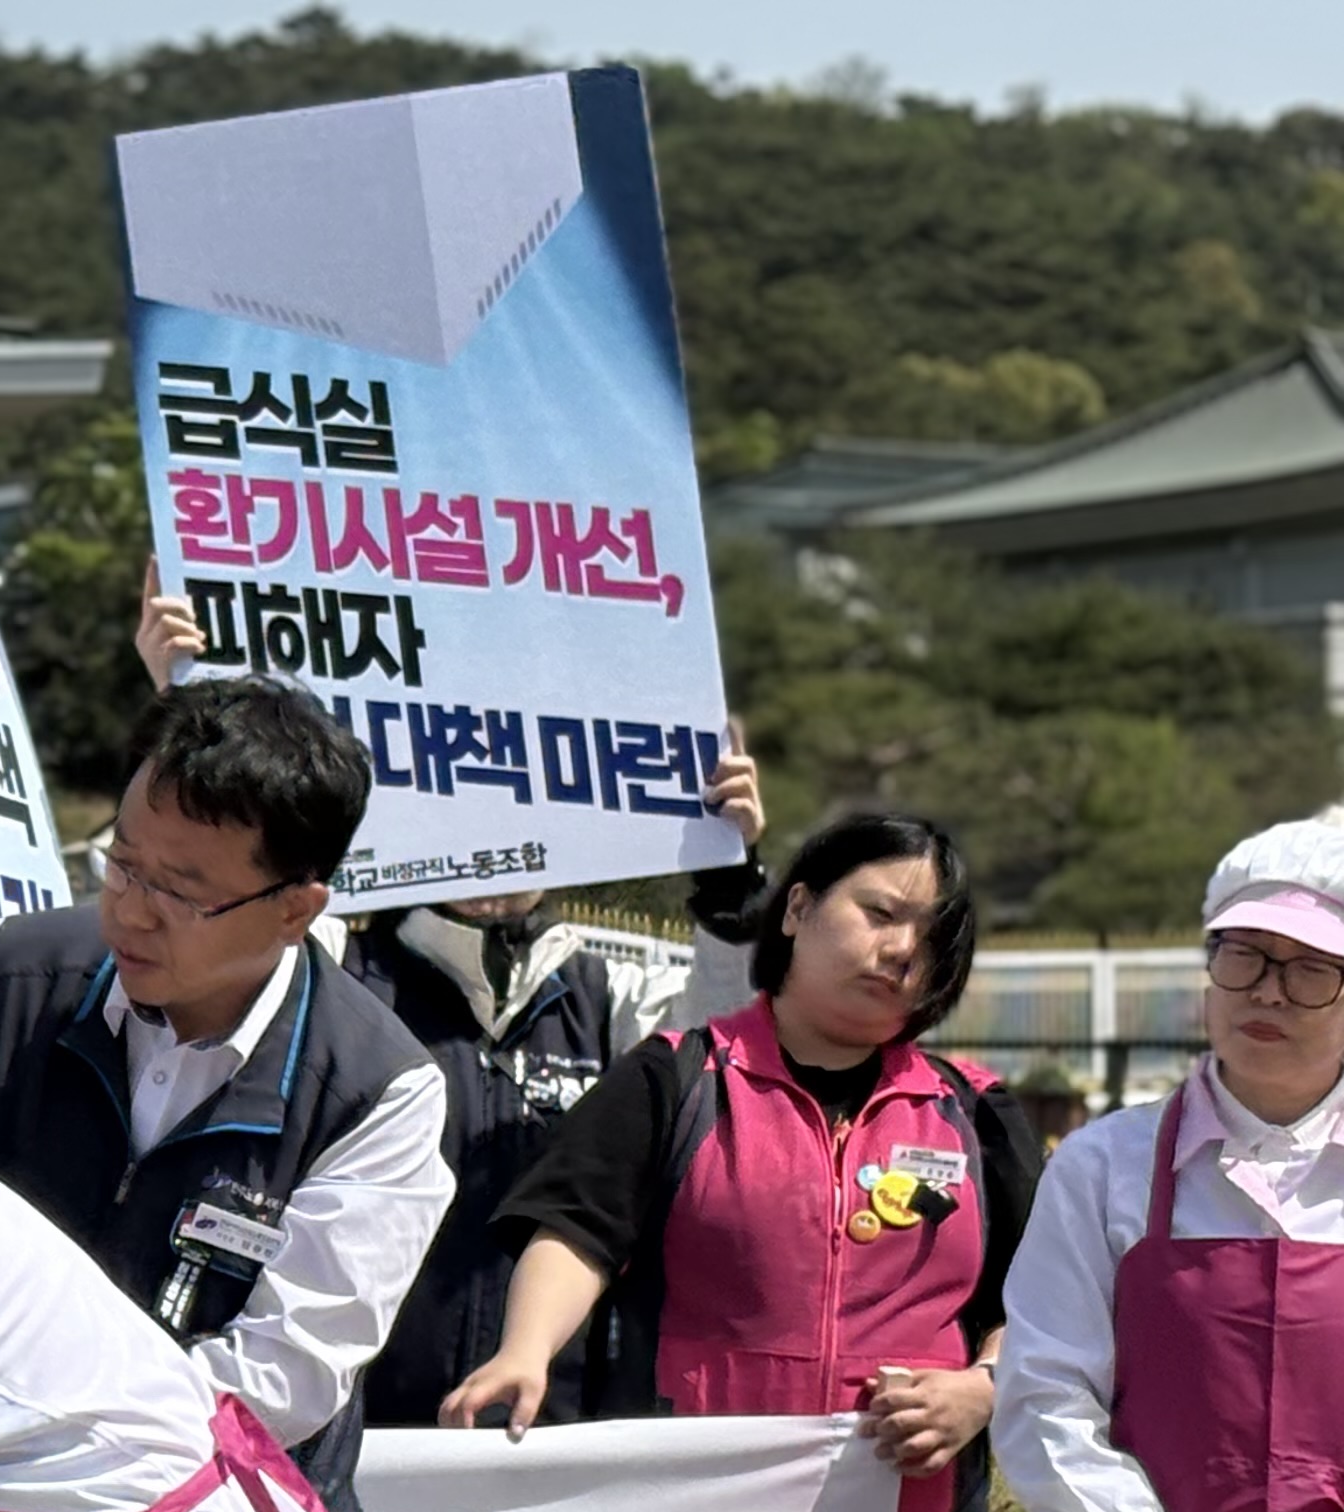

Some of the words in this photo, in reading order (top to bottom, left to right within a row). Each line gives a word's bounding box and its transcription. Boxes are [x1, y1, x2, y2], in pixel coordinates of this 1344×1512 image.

[158, 361, 398, 474] 급식실
[183, 577, 426, 687] 피해자
[366, 699, 532, 805] 대책
